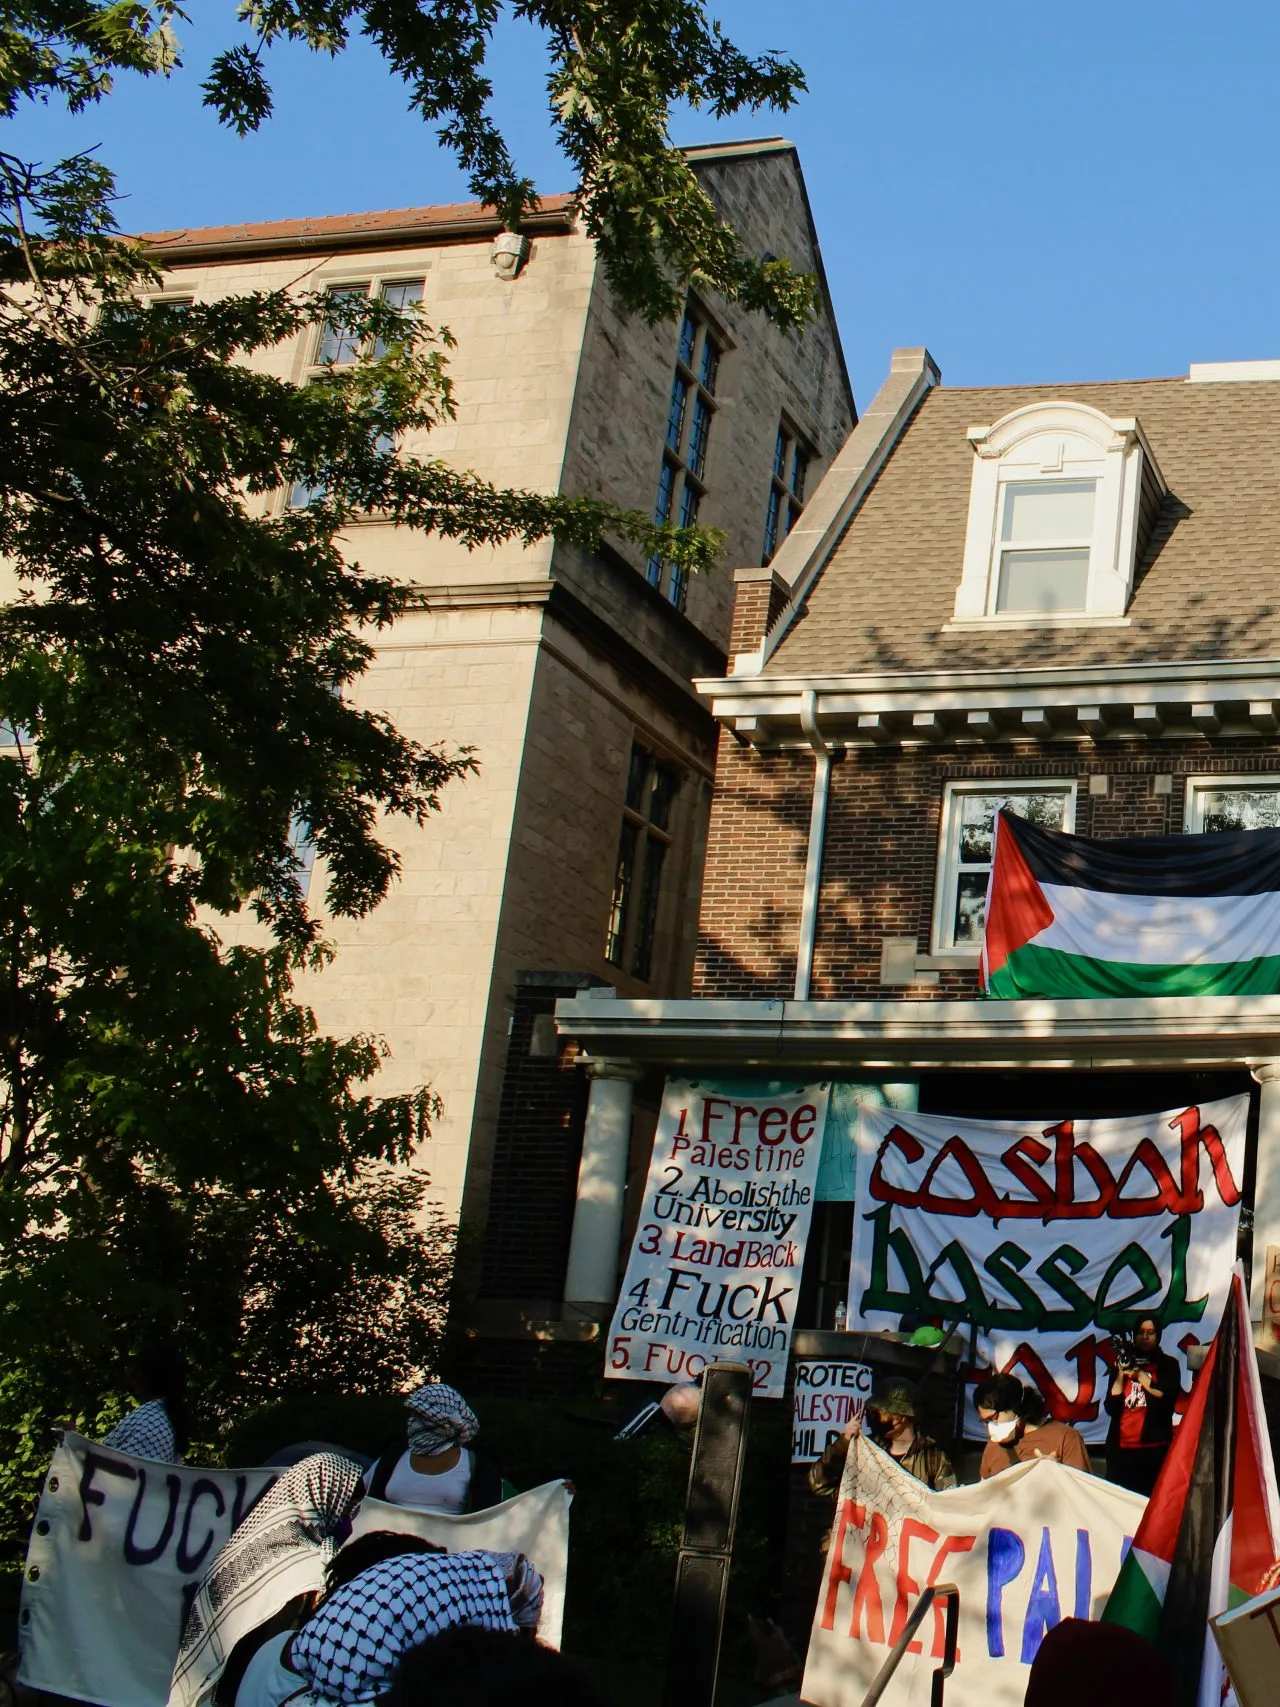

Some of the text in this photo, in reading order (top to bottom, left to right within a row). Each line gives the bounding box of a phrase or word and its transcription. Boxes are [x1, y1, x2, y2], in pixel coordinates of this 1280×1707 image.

[675, 1097, 817, 1146] 1. Free
[669, 1135, 806, 1172] Palestine
[658, 1166, 683, 1198] 2.
[653, 1195, 798, 1241] University
[638, 1224, 662, 1256] 3.
[628, 1267, 794, 1325] 4. Fuck
[620, 1306, 788, 1350] Gentrification
[611, 1337, 631, 1370] 5.
[795, 1364, 872, 1392] ROTEC
[794, 1394, 870, 1428] ALESTINIA
[821, 1500, 976, 1664] FREE
